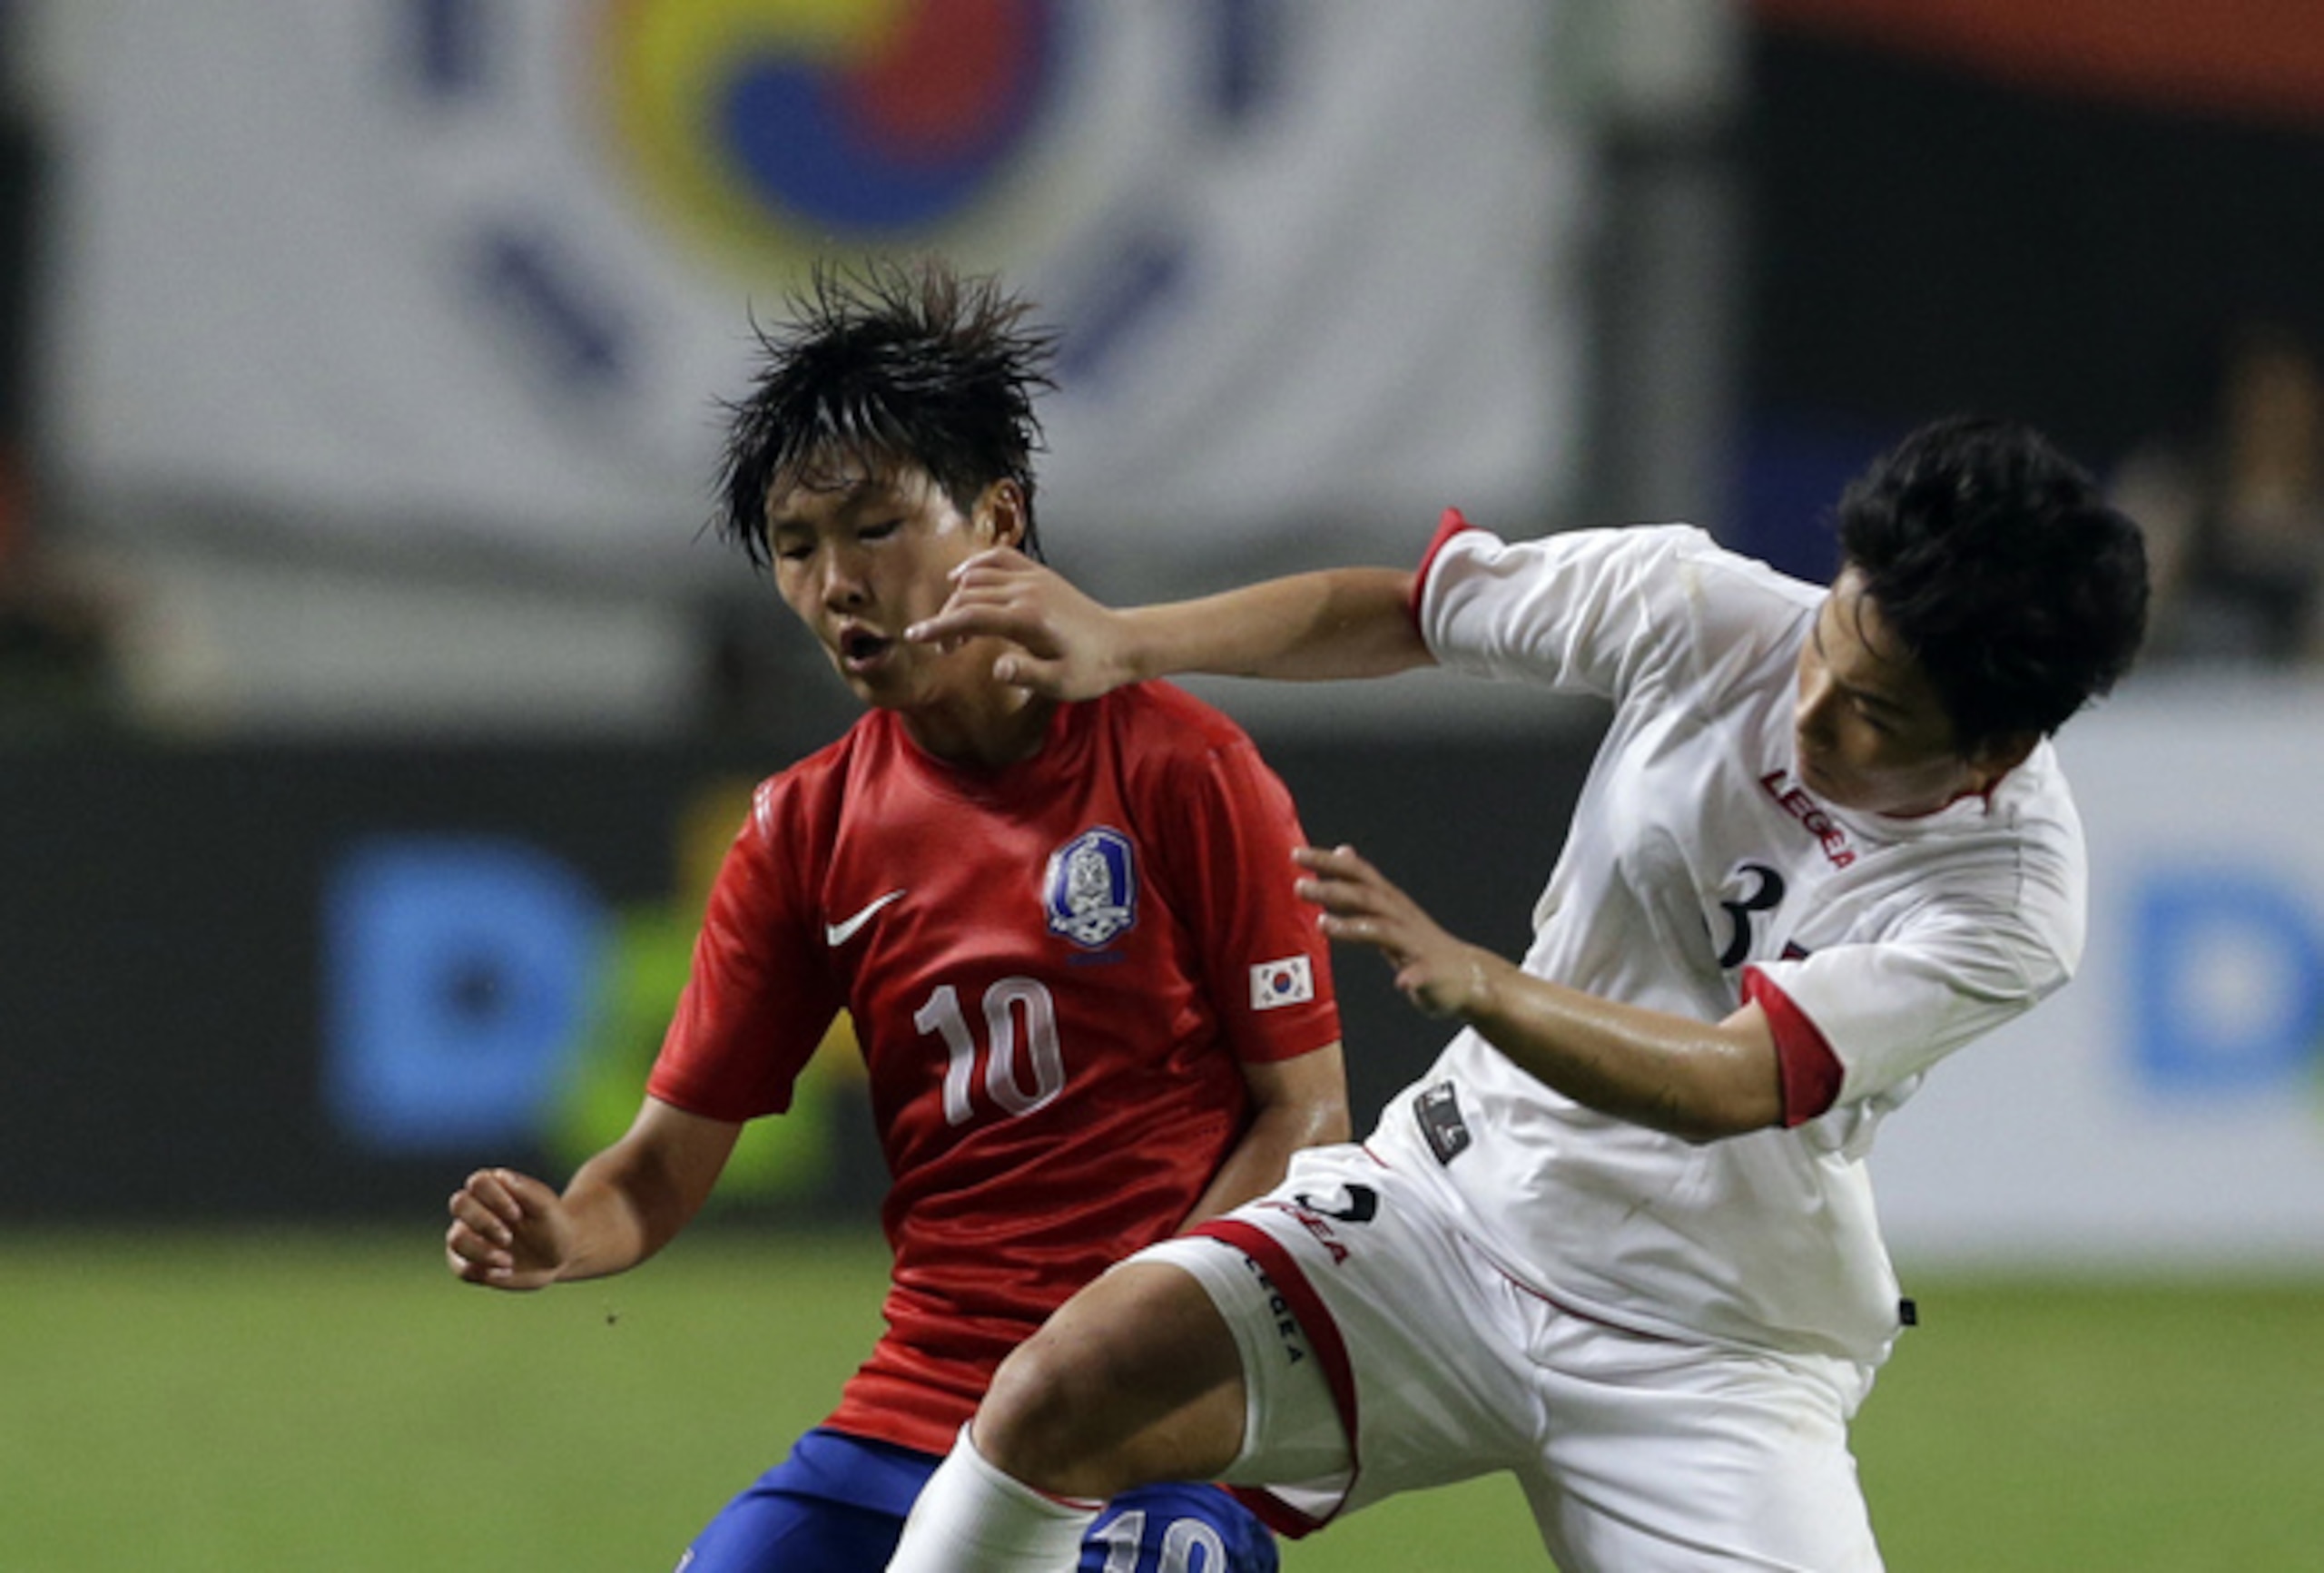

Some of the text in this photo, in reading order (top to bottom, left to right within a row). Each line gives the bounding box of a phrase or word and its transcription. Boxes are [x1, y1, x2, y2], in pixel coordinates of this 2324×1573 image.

[1759, 769, 1856, 870] LEGEA
[1719, 864, 1786, 968] 3
[913, 977, 1065, 1126] 10
